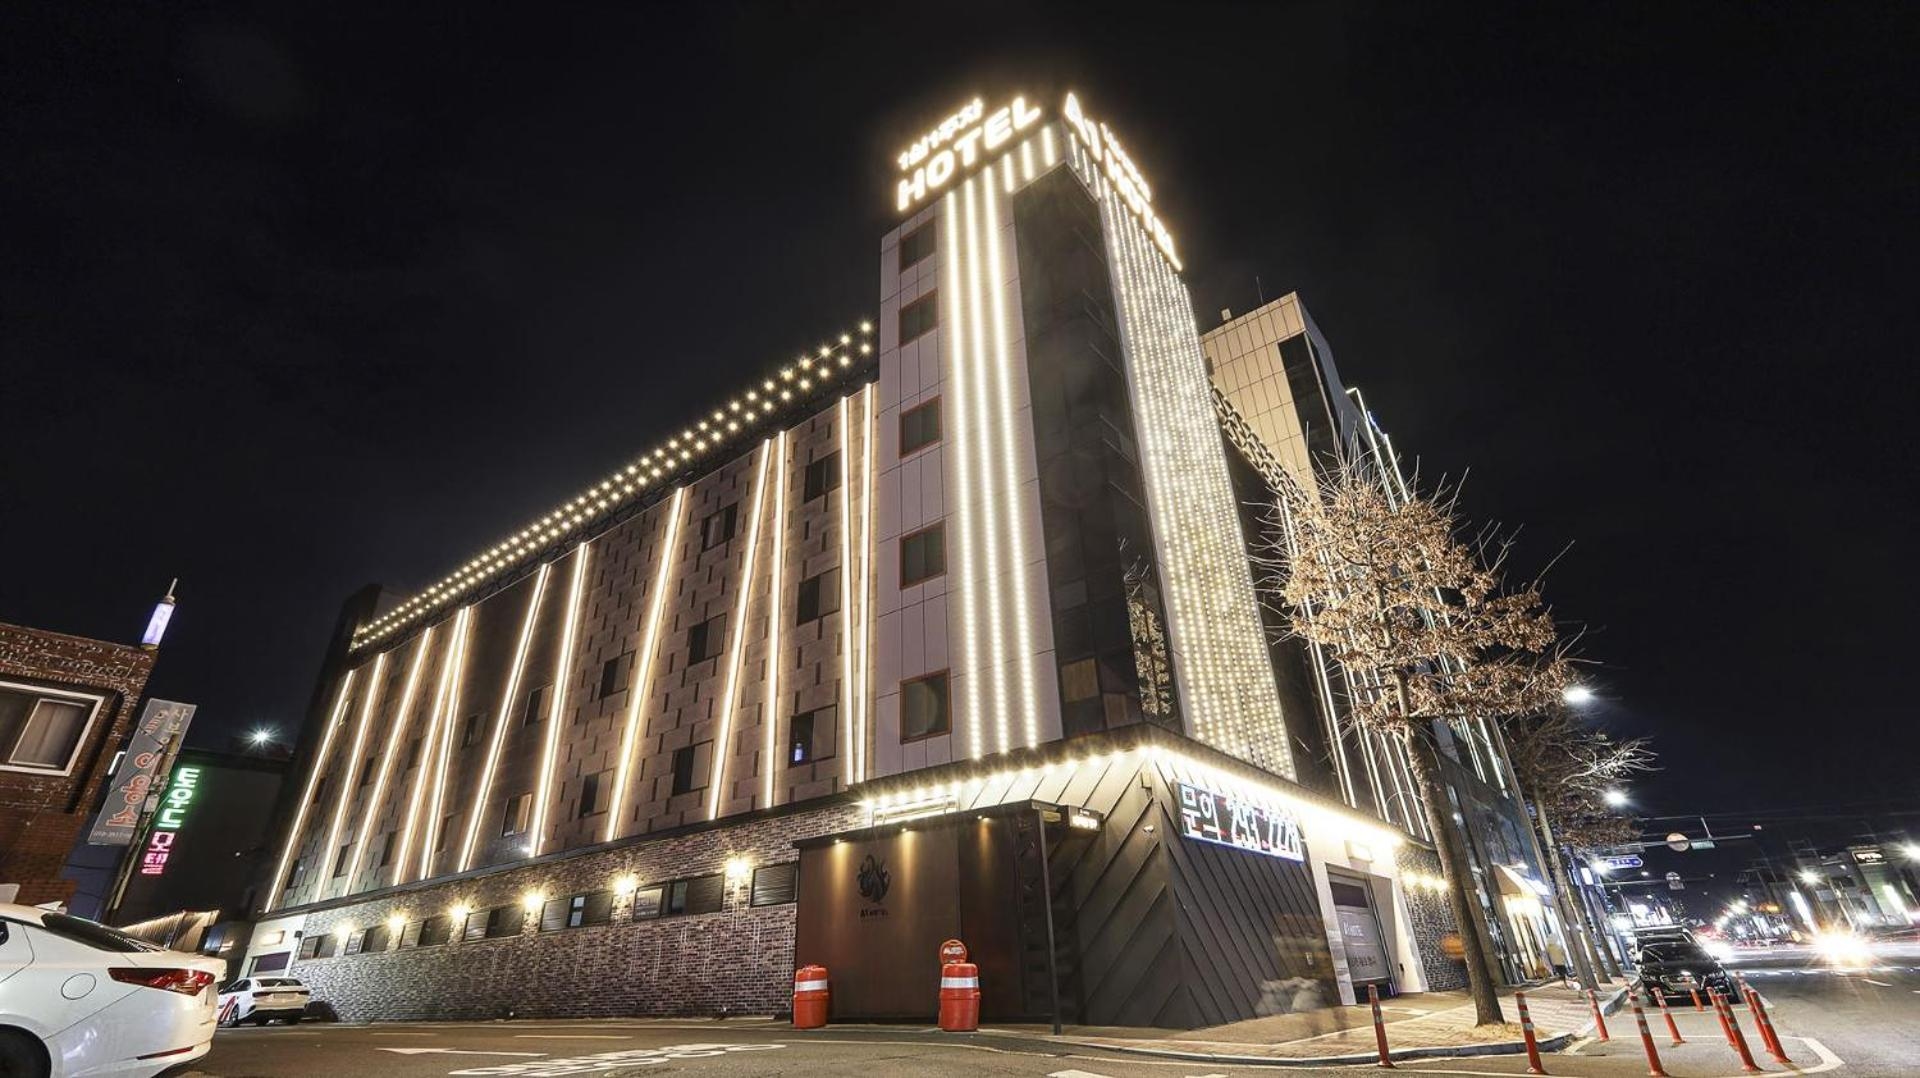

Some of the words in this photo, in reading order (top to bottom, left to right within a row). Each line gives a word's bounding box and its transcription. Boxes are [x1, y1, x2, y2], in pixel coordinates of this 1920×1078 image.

[898, 97, 1041, 211] HOTEL
[1181, 785, 1222, 843] 문의
[141, 831, 175, 875] 모텔
